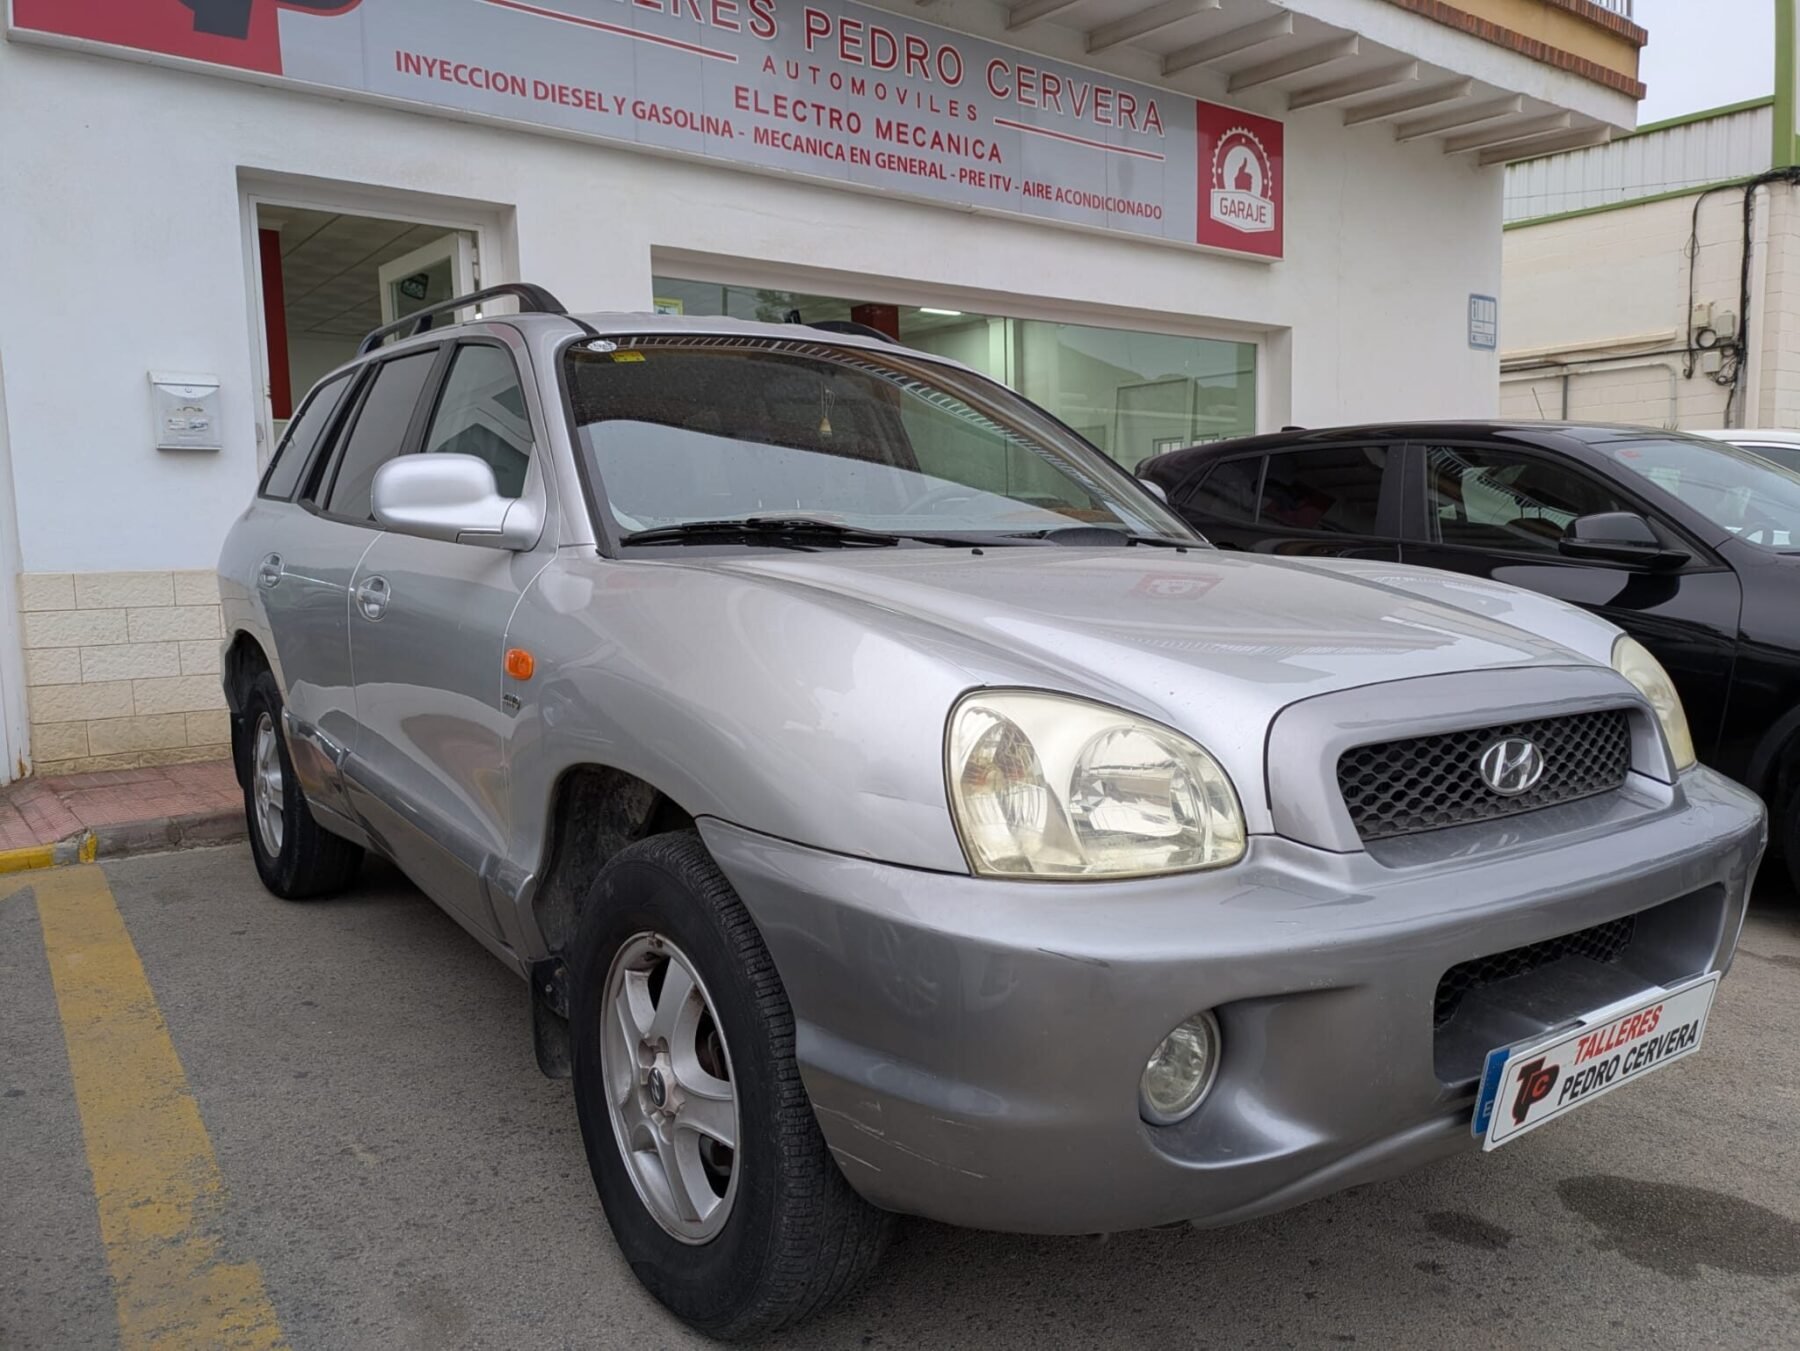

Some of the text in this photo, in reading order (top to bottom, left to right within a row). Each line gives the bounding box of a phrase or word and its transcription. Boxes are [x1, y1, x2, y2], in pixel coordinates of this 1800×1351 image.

[762, 54, 977, 121] AUTOMOVILES
[804, 5, 964, 87] PEDRO
[986, 58, 1165, 137] CERVERA
[395, 50, 528, 97] INYECCION
[532, 79, 609, 113] DIESEL
[613, 95, 626, 116] Y
[631, 100, 734, 138] GASOLINA
[753, 125, 846, 163] MECANICA
[850, 146, 871, 167] EN
[874, 151, 947, 181] GENERAL
[959, 169, 986, 189] PRE
[988, 173, 1012, 194] ITV
[1022, 179, 1053, 201] AIRE
[1055, 186, 1163, 220] ACONDICIONADO
[734, 84, 1003, 164] ELECTRO MECANICA
[1219, 196, 1267, 224] GARAJE
[1557, 1019, 1700, 1106] PEDRO CERVERA
[1574, 1004, 1664, 1066] TALLERES
